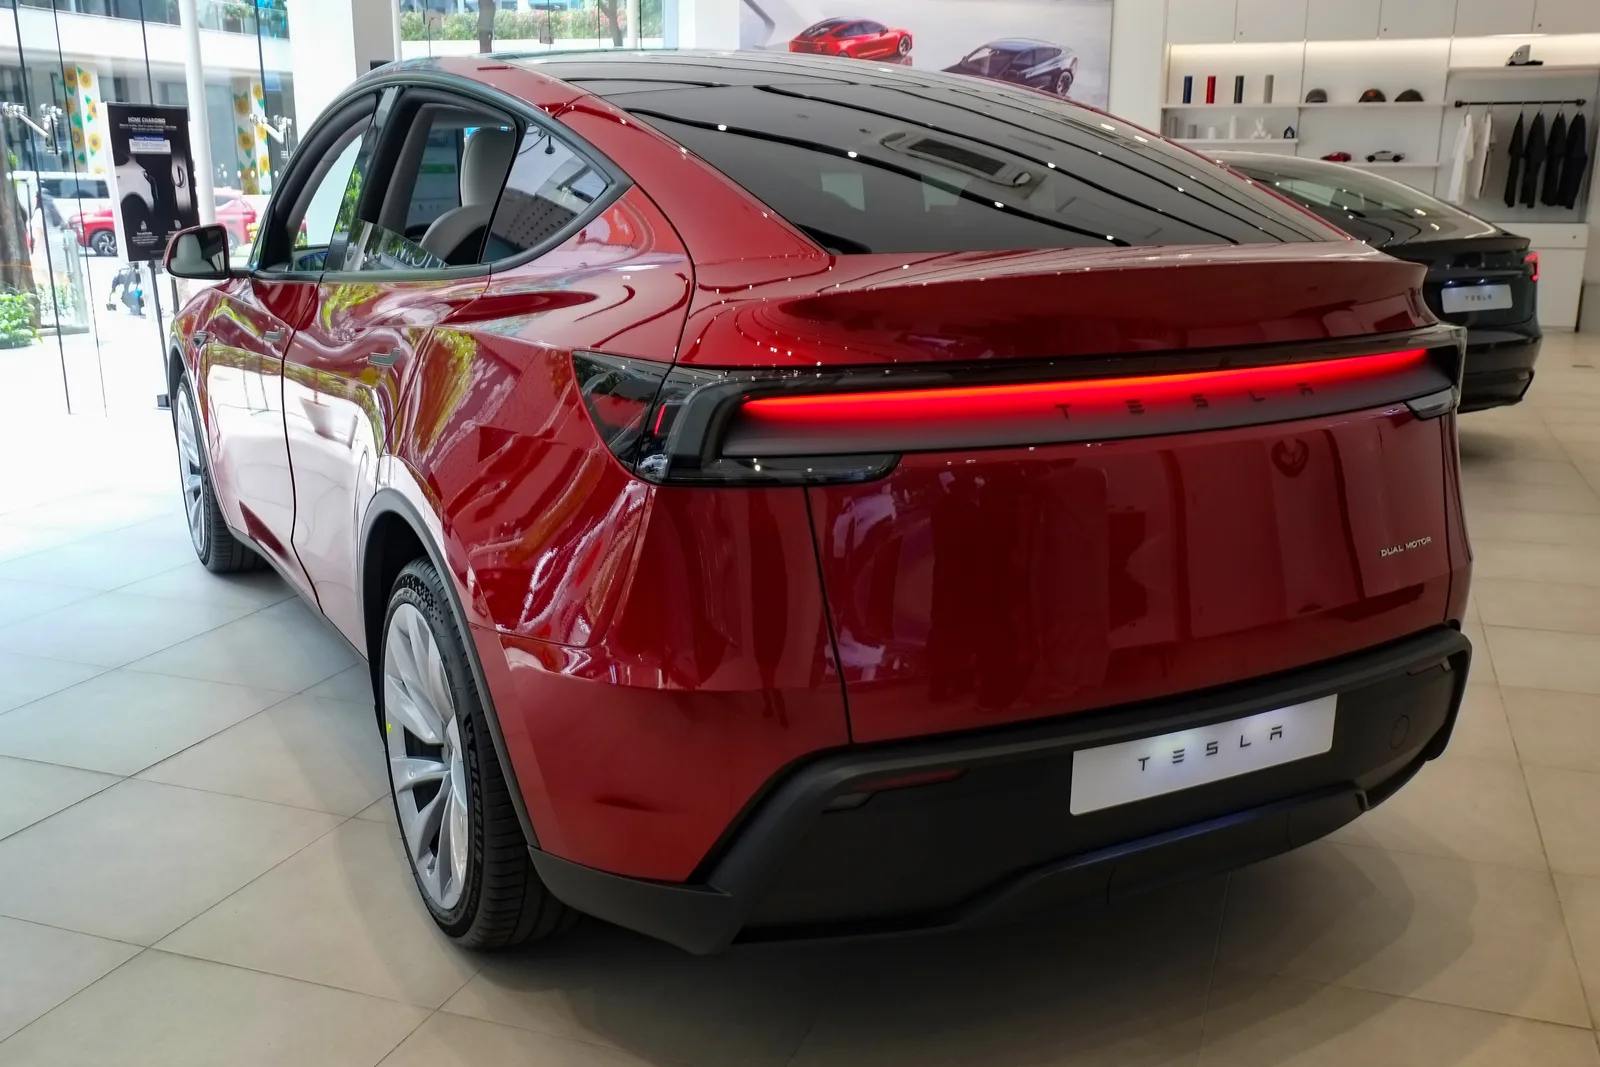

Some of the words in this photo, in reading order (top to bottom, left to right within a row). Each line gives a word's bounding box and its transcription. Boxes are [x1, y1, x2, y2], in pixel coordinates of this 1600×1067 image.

[1055, 382, 1315, 420] TESLA
[1381, 545, 1404, 556] DUAL
[1405, 536, 1431, 549] MOTOR
[1137, 725, 1283, 772] TESLA
[468, 749, 483, 865] MICHELIN
